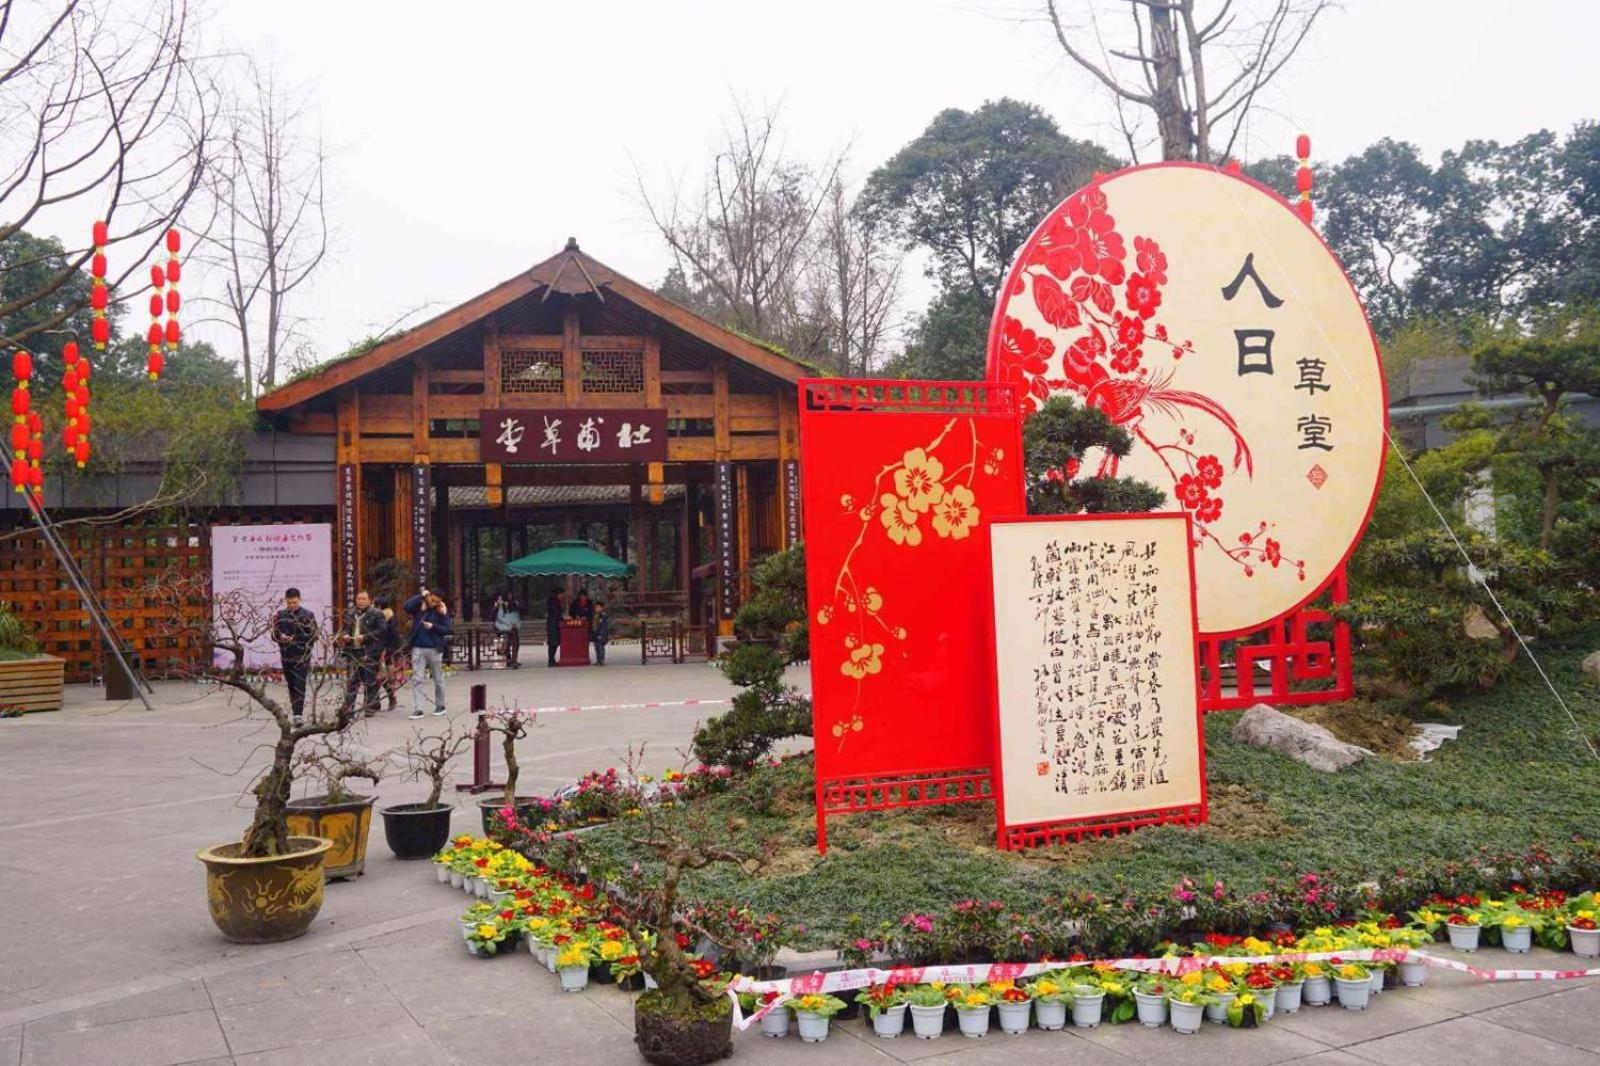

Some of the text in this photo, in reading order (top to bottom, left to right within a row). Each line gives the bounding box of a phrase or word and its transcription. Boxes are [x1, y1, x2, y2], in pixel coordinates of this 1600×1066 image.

[1221, 252, 1285, 377] 人日
[496, 415, 652, 455] 杜甫草堂
[1294, 357, 1334, 452] 草堂
